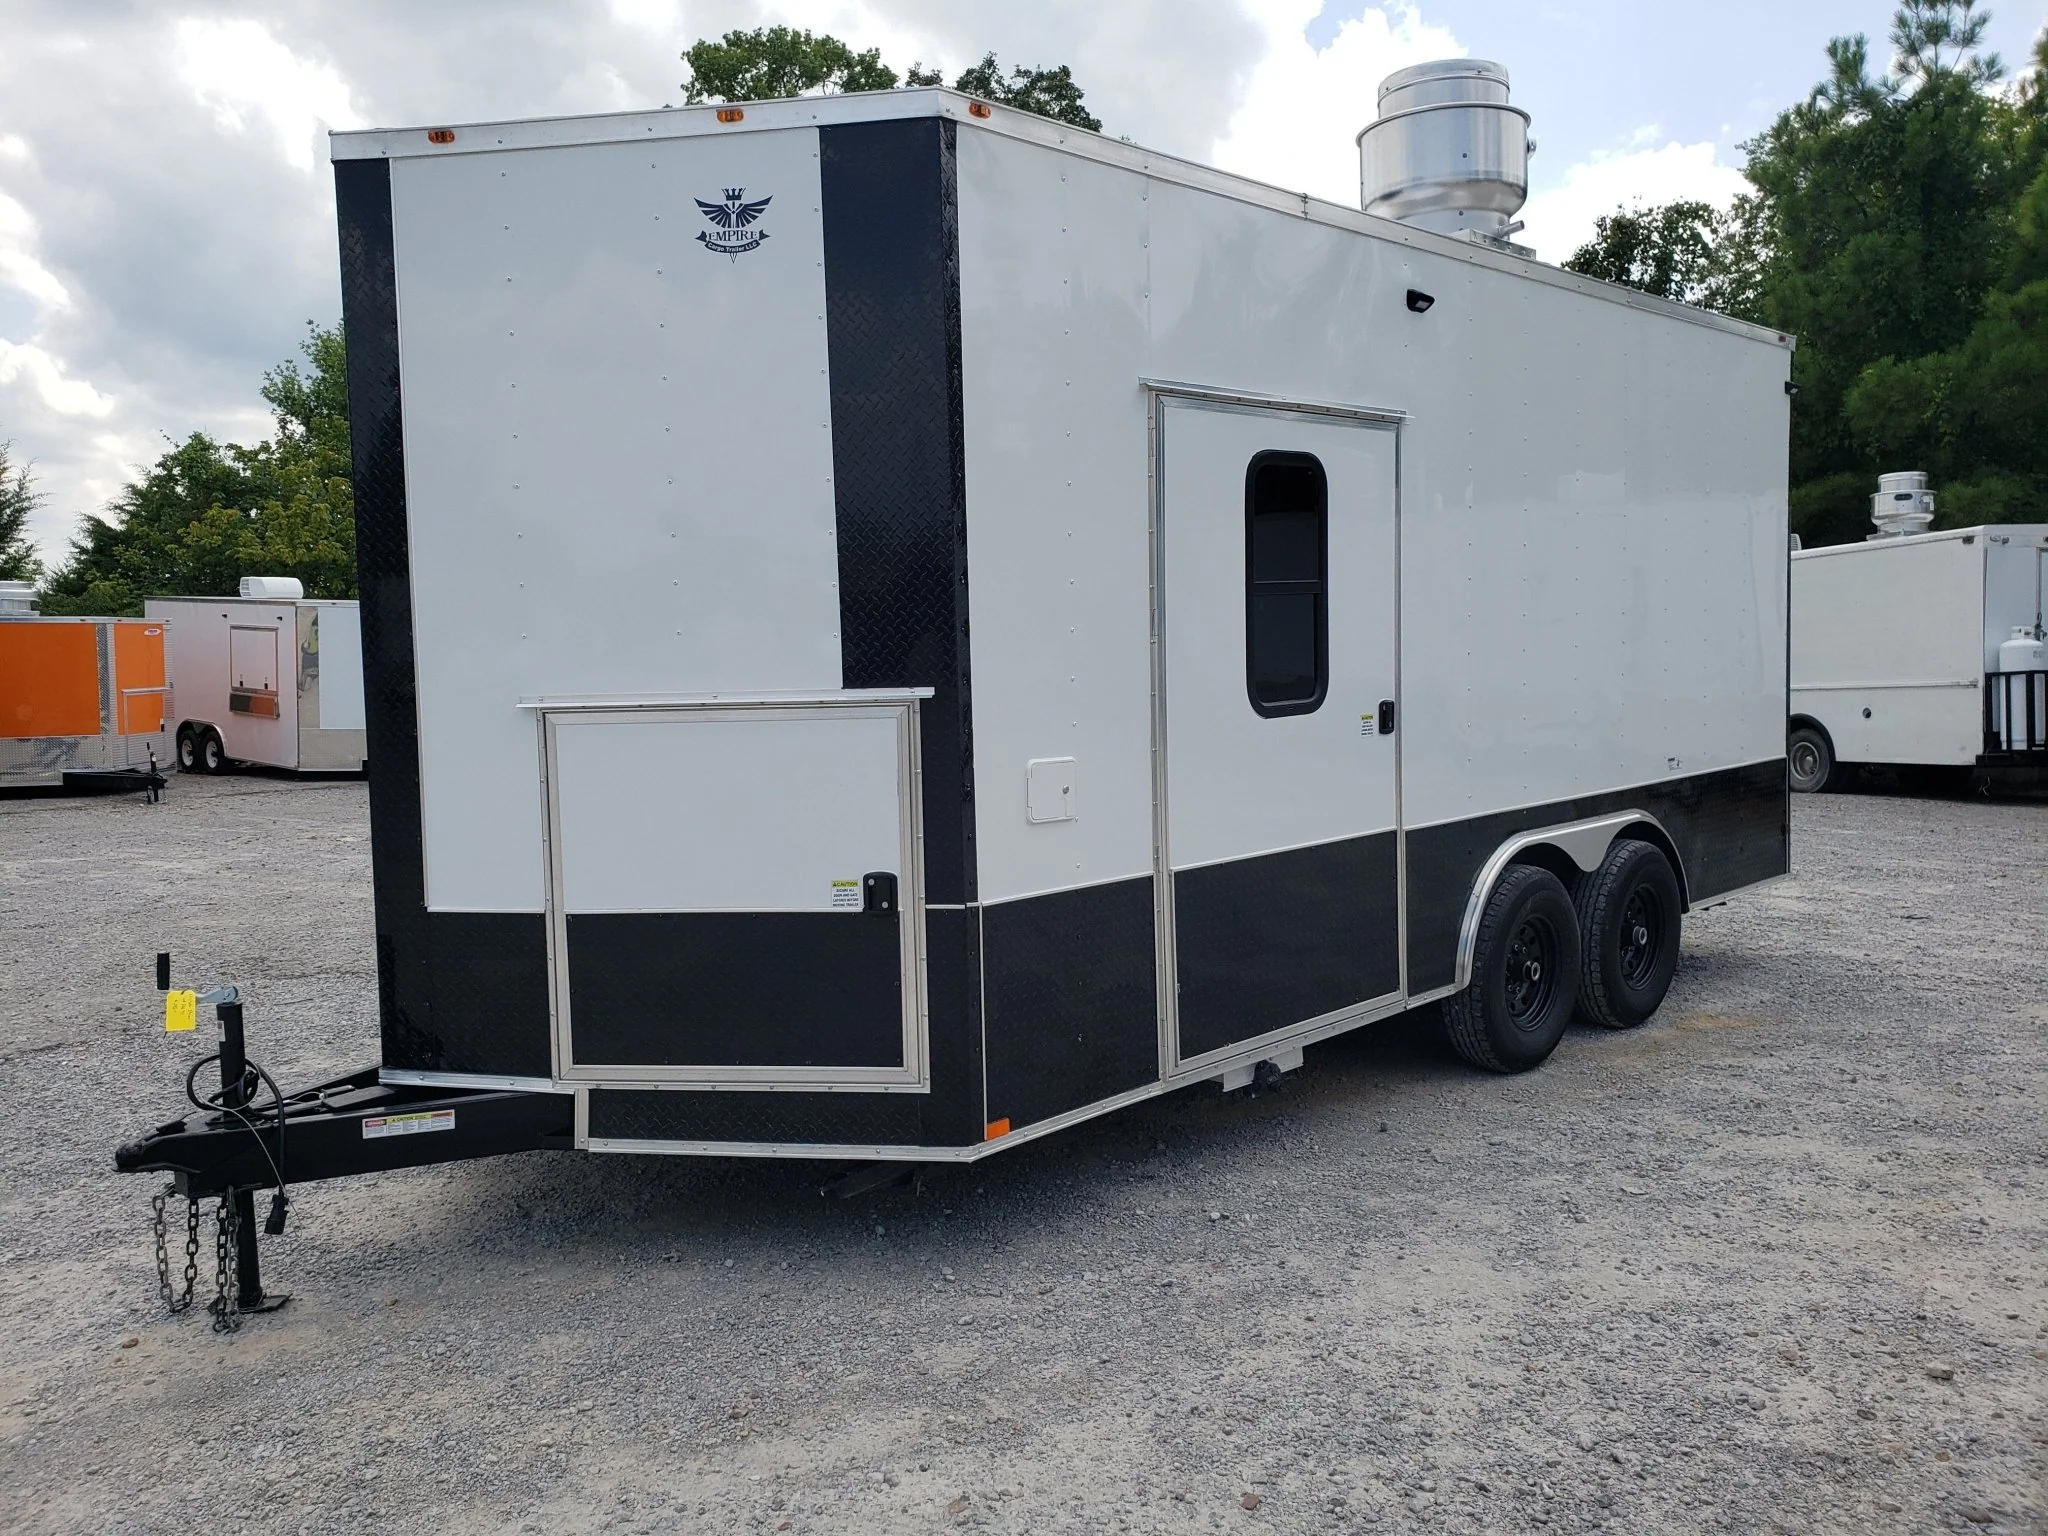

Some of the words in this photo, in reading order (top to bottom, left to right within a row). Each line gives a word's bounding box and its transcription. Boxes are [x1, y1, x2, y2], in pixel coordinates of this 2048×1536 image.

[708, 230, 758, 241] EMPIRE
[707, 242, 724, 252] Cargo
[745, 242, 758, 250] LLC
